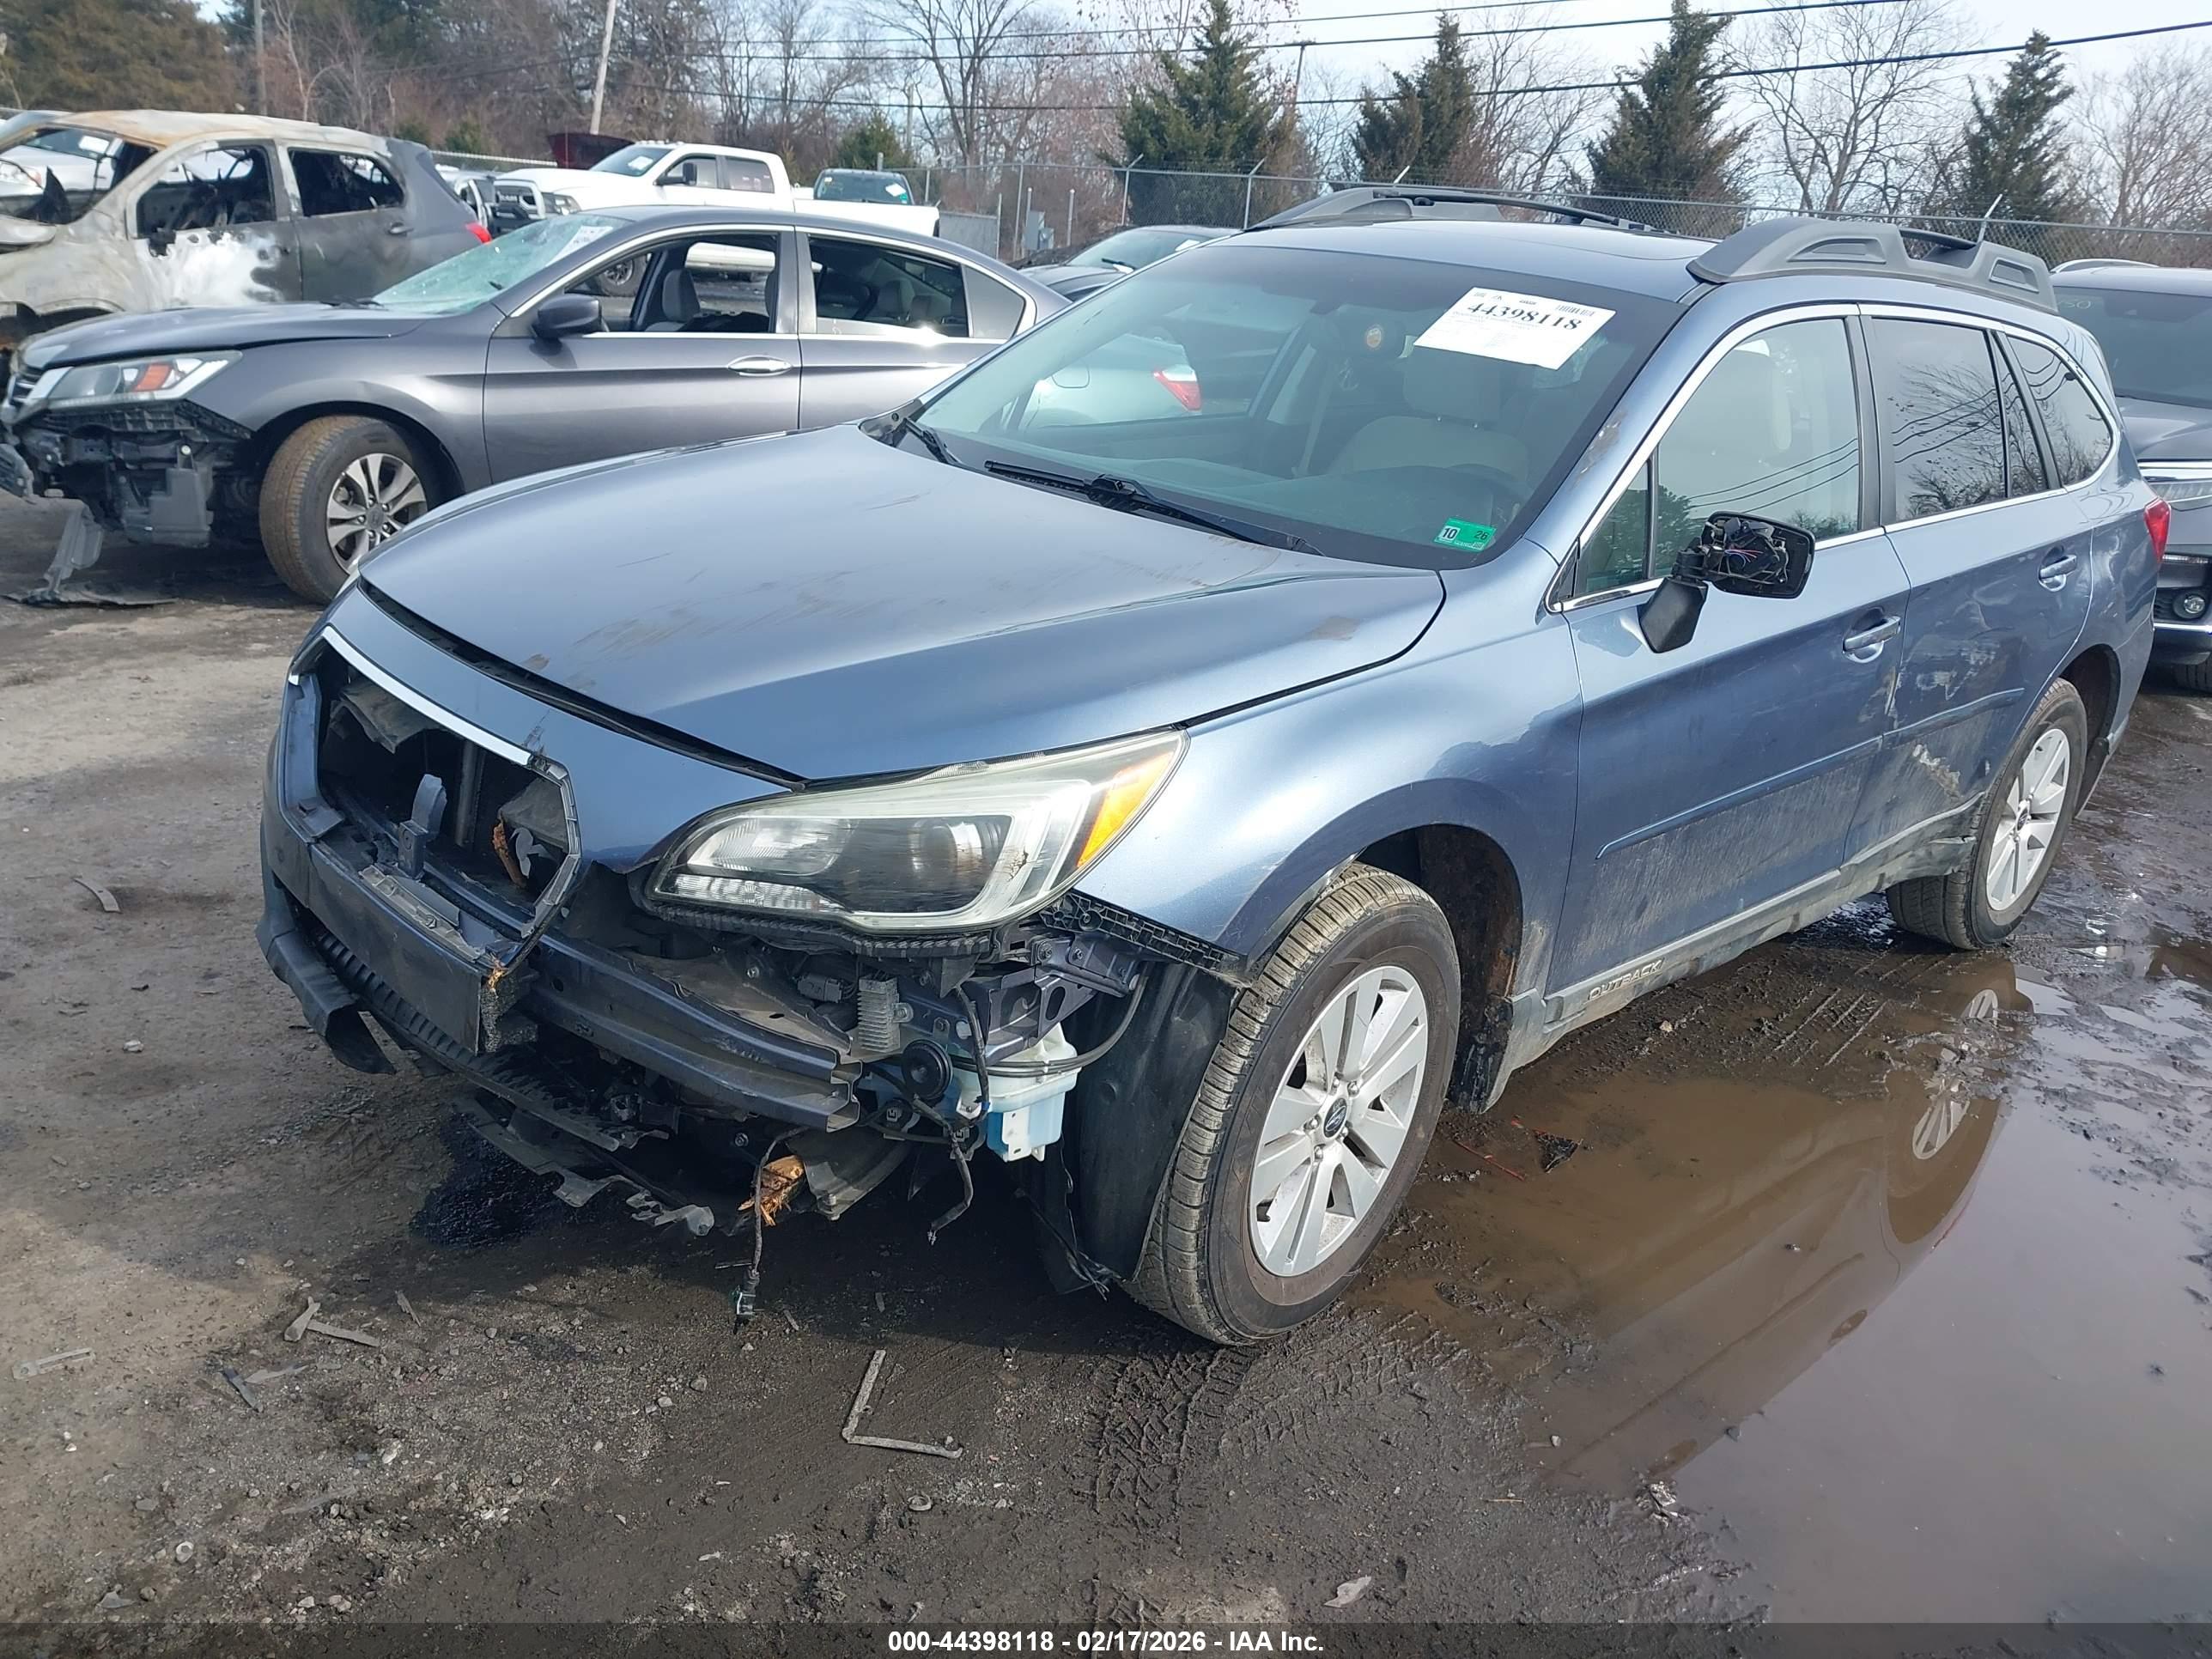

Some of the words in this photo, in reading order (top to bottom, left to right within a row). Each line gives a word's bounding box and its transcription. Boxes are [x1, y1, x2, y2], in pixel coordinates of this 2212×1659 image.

[1467, 302, 1583, 331] 44398118
[1442, 527, 1458, 539] 10
[1474, 530, 1490, 540] 26
[1588, 958, 1665, 1000] OUTBACK
